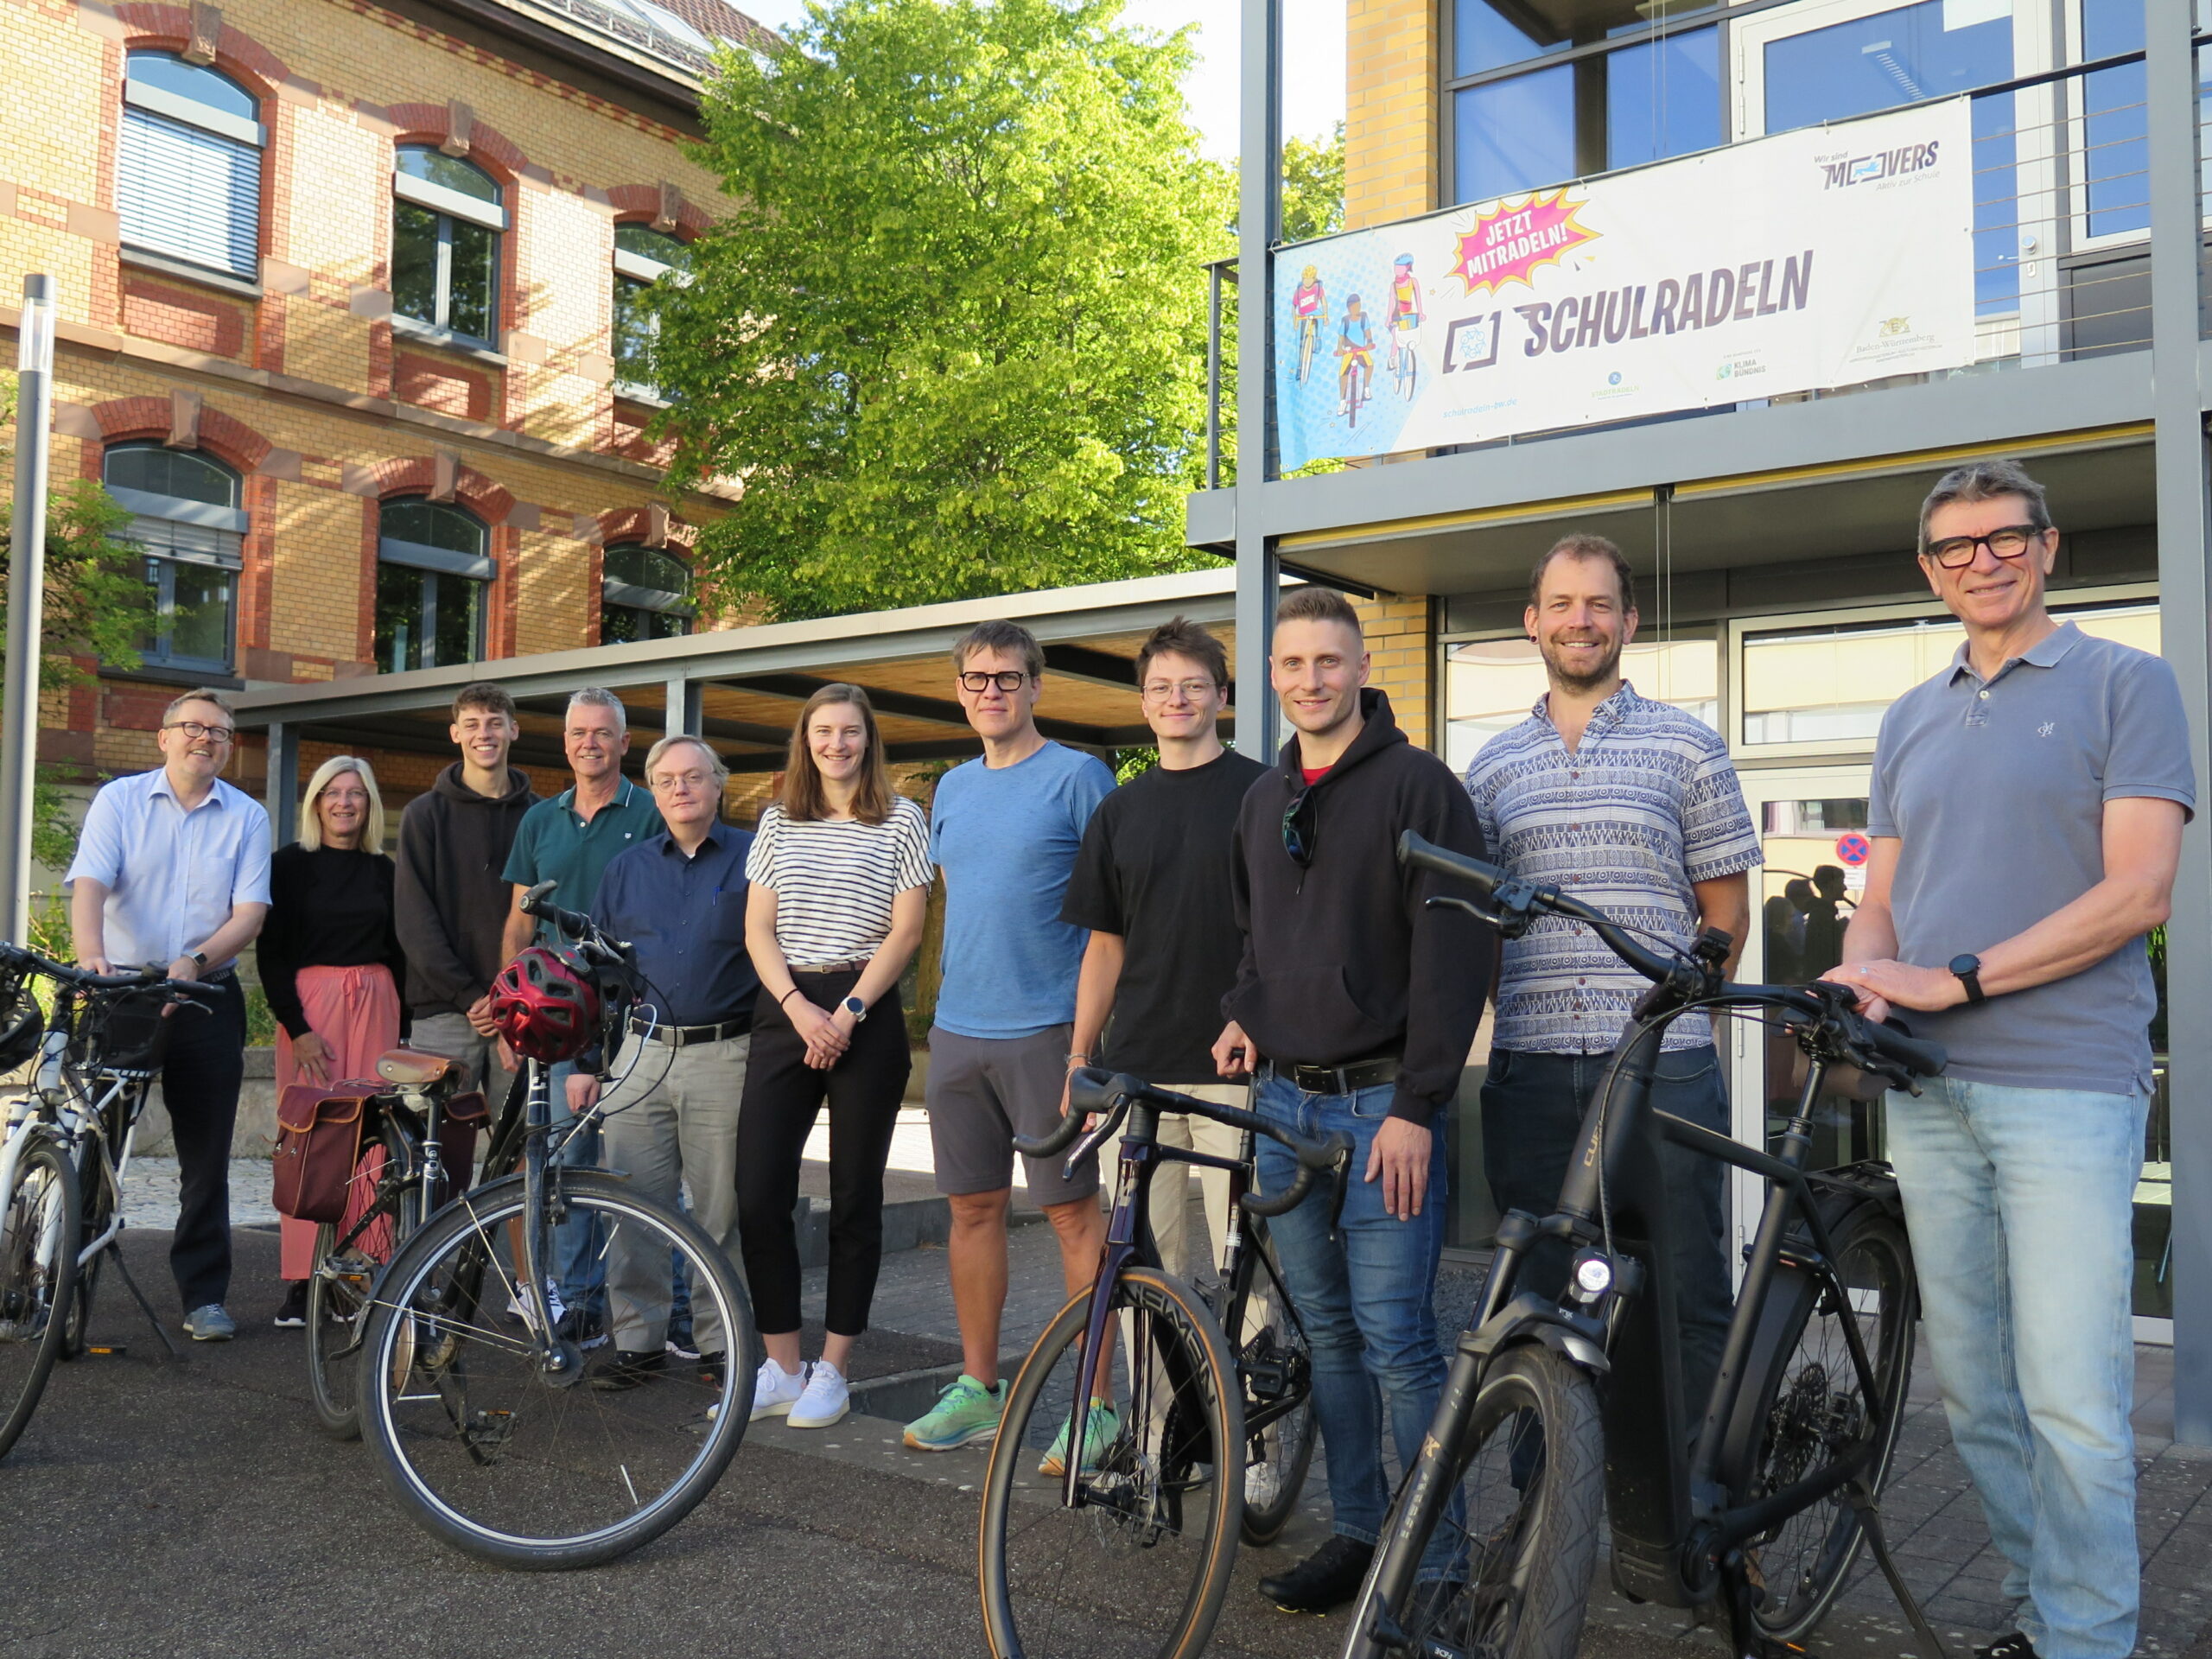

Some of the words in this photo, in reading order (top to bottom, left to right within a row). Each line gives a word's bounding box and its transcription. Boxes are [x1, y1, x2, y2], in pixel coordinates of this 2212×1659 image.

[1814, 155, 1828, 163] Wir
[1831, 150, 1849, 162] sind
[1914, 170, 1941, 184] Schule
[1485, 210, 1532, 246] JETZT
[1466, 222, 1568, 279] MITRADELN!
[1512, 249, 1814, 358] SCHULRADELN
[1856, 334, 1936, 353] Baden-Württemberg
[1733, 359, 1757, 370] KLIMA
[1442, 397, 1518, 418] schulradeln-bw.de
